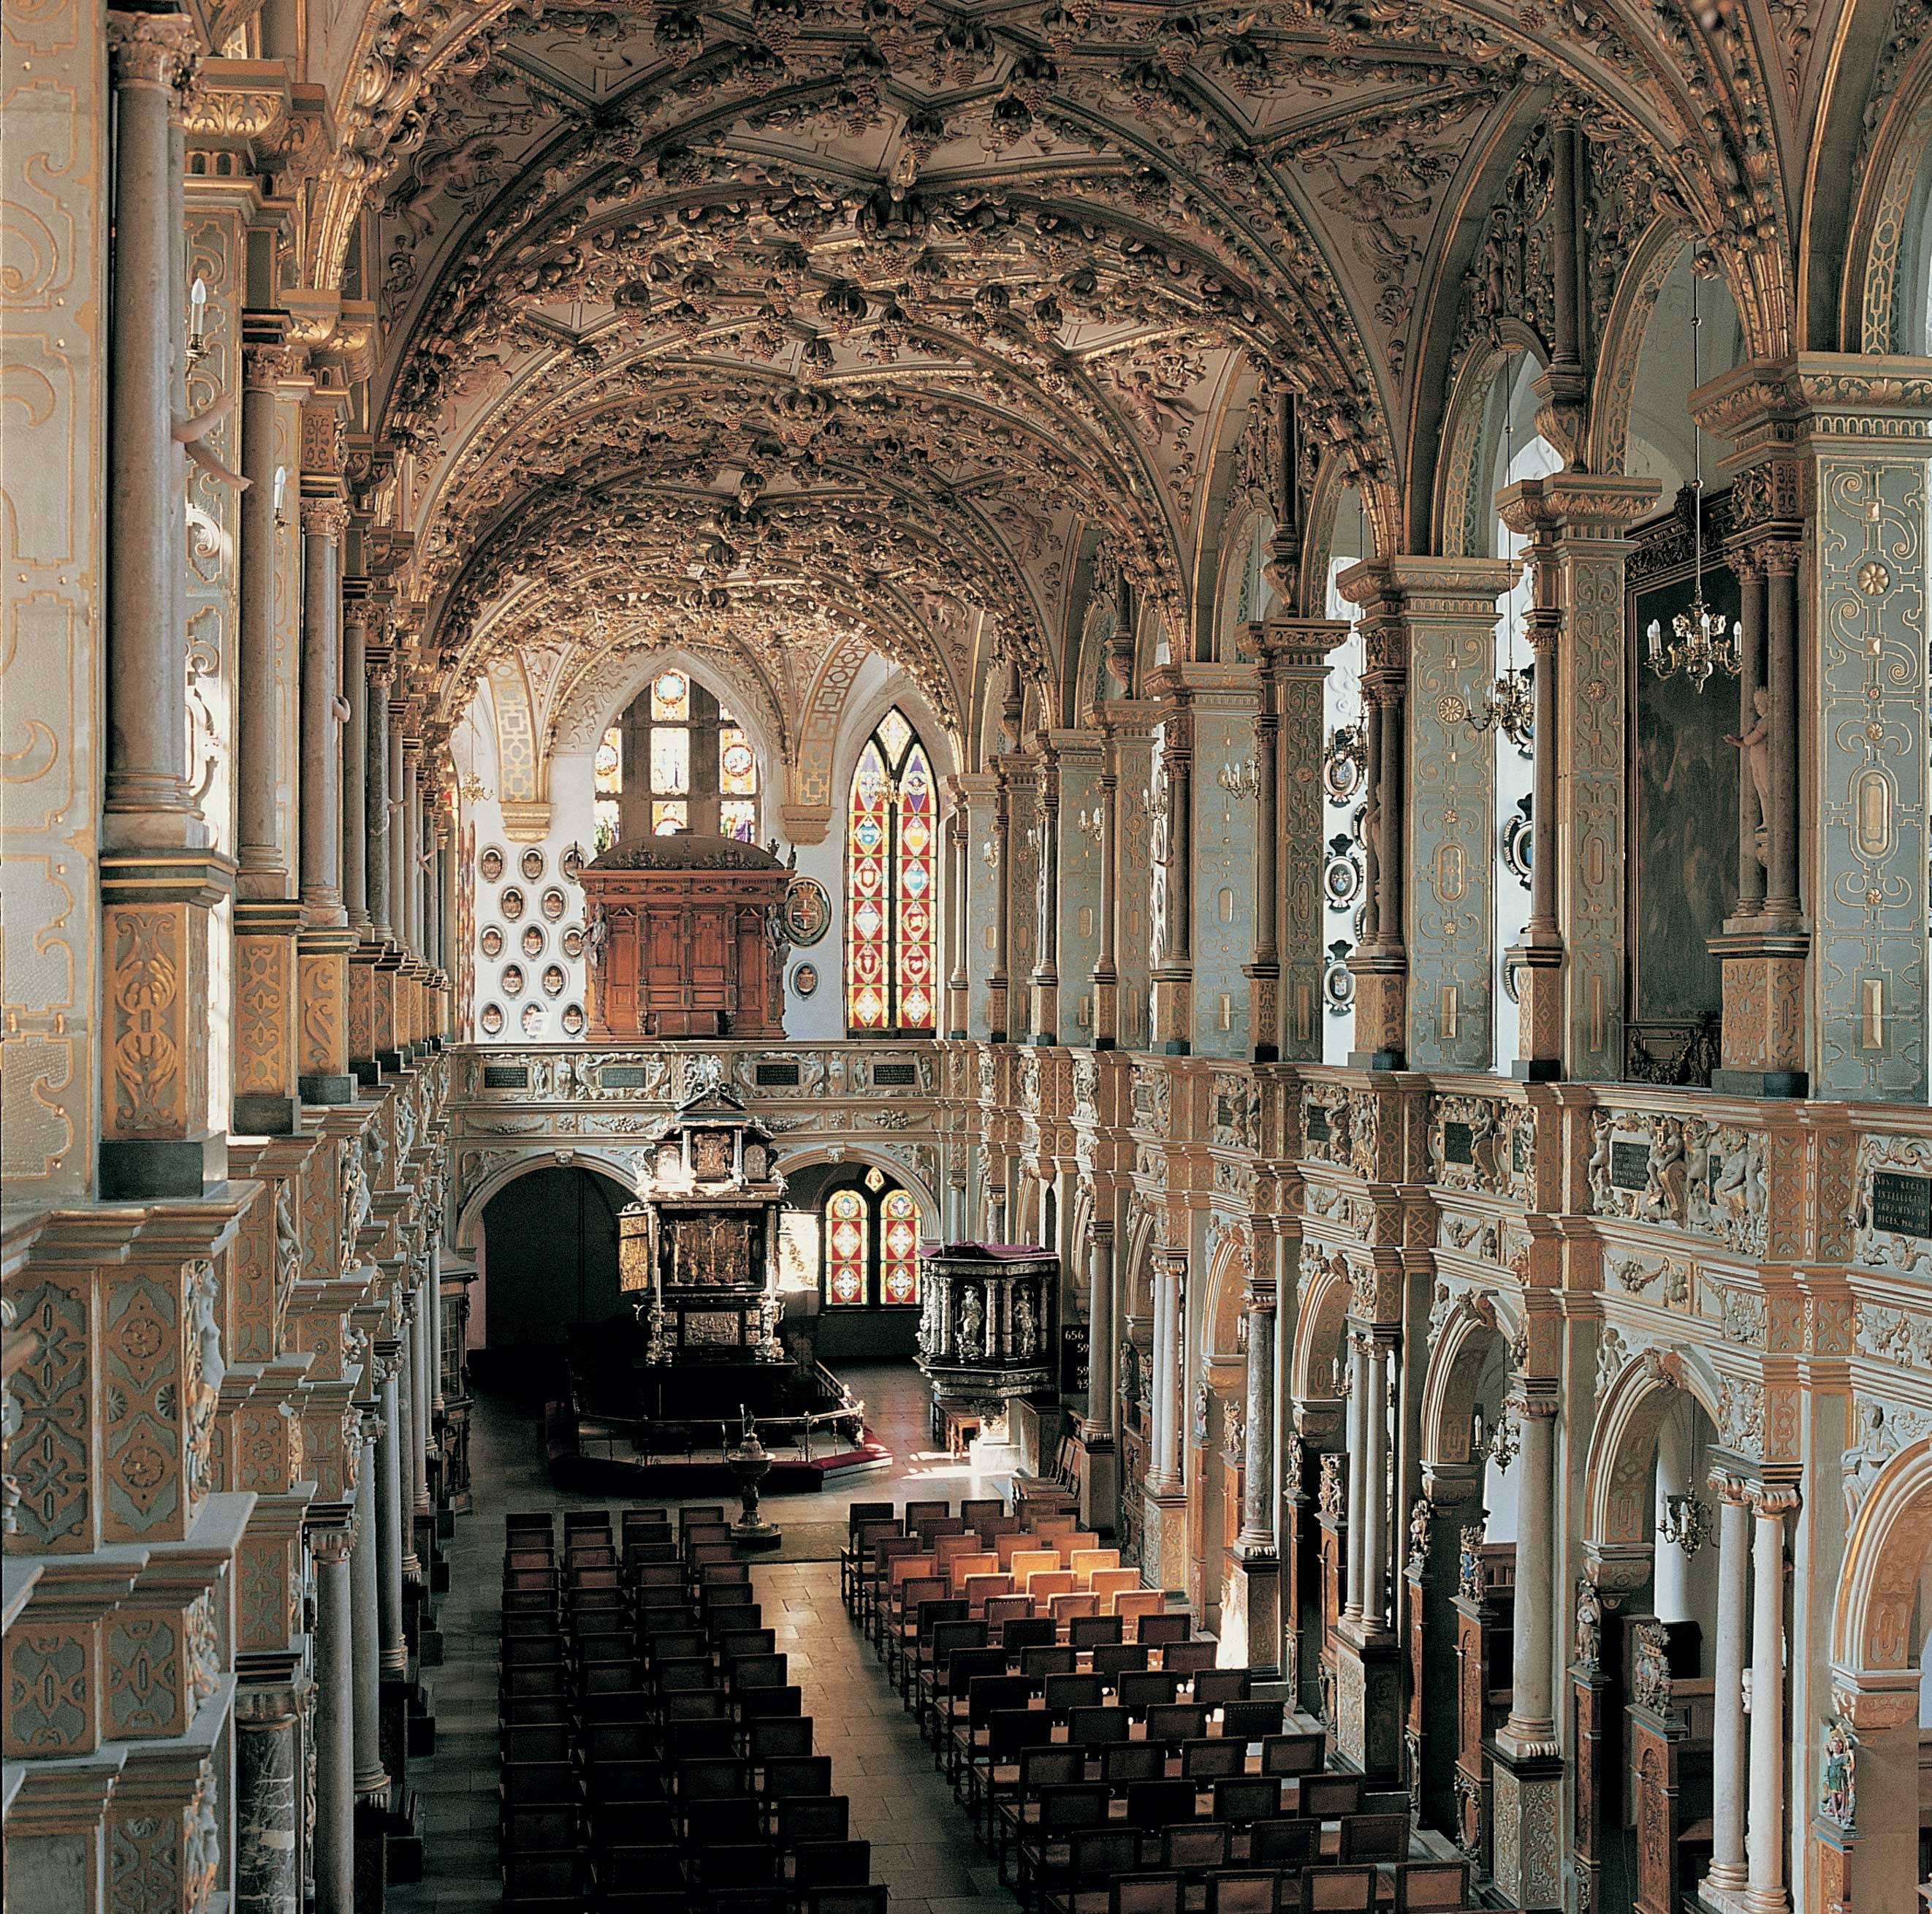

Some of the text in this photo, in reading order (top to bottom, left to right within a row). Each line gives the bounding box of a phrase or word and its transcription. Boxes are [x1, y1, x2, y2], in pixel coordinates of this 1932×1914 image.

[1065, 1330, 1084, 1340] 656
[1077, 1343, 1089, 1353] 59
[1076, 1366, 1089, 1376] 59
[1076, 1379, 1089, 1389] 43
